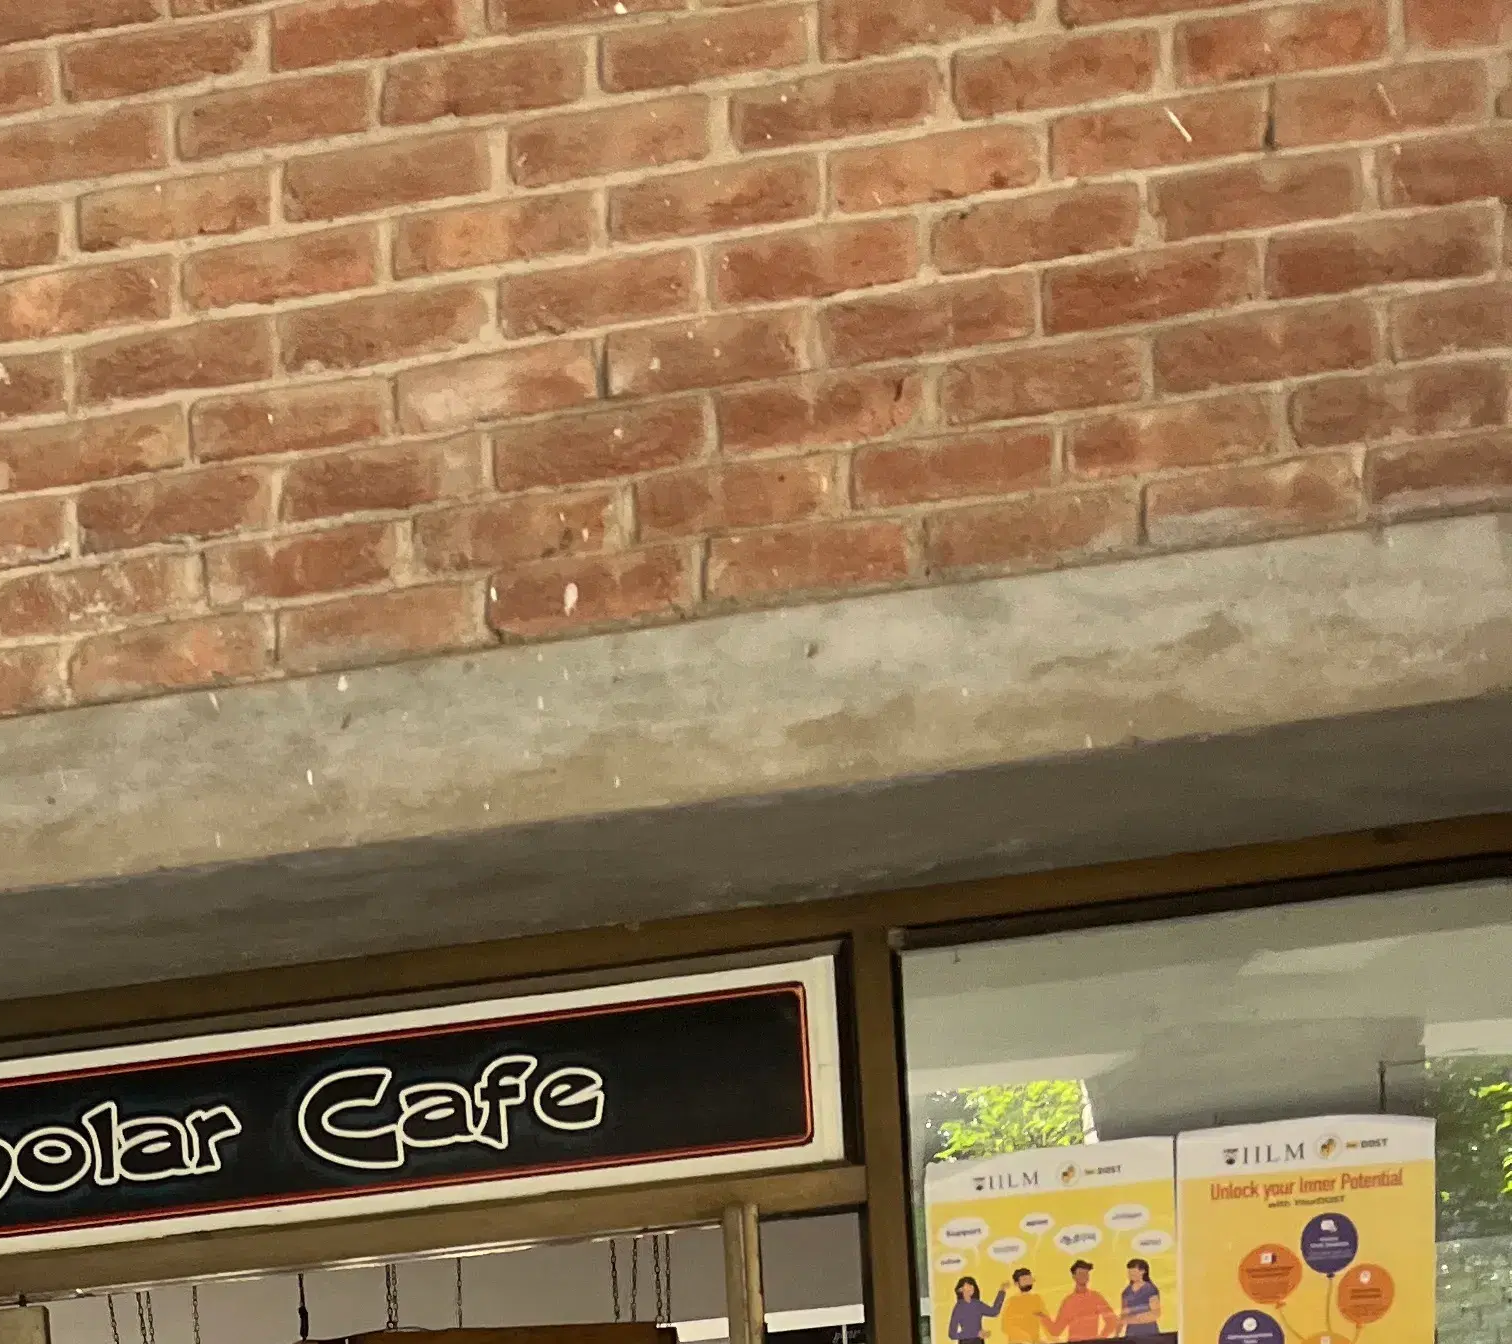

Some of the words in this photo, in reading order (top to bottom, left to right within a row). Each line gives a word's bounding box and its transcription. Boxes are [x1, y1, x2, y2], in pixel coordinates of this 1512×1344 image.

[296, 1054, 606, 1168] Cafe
[1243, 1142, 1305, 1164] IILM
[989, 1171, 1039, 1190] IILM
[1211, 1181, 1259, 1200] Unlock
[1263, 1181, 1295, 1201] your
[1300, 1176, 1336, 1193] Inner
[1340, 1168, 1404, 1190] Potential
